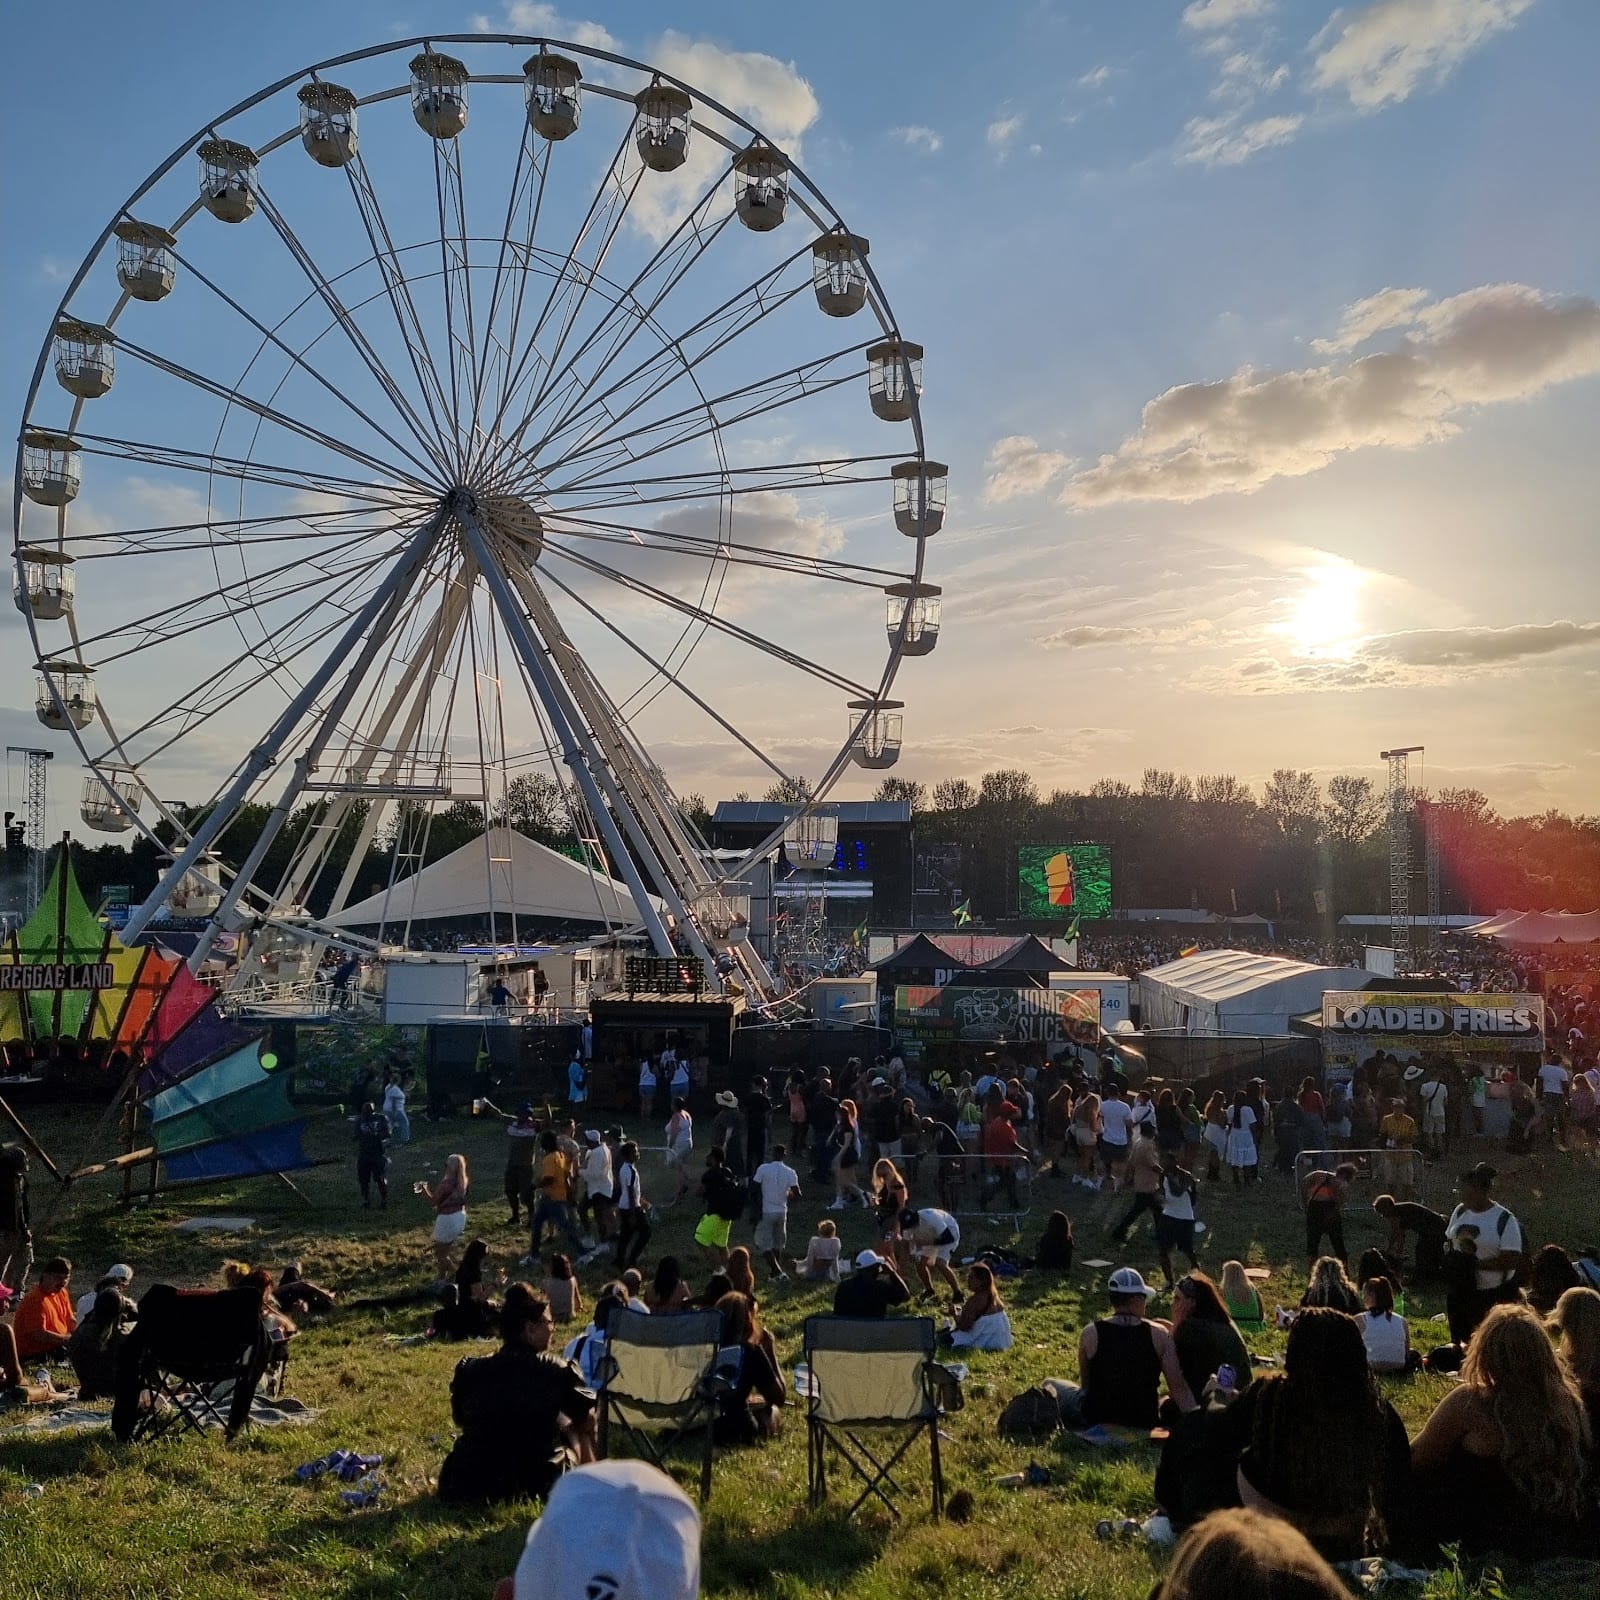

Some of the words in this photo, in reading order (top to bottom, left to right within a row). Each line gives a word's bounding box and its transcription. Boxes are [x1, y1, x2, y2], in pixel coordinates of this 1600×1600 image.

[1, 965, 65, 989] REGGAE
[70, 965, 112, 988] LAND
[1018, 990, 1064, 1015] HOME
[1019, 1016, 1064, 1041] SLICE
[1328, 1005, 1445, 1031] LOADED
[1453, 1007, 1531, 1032] FRIES
